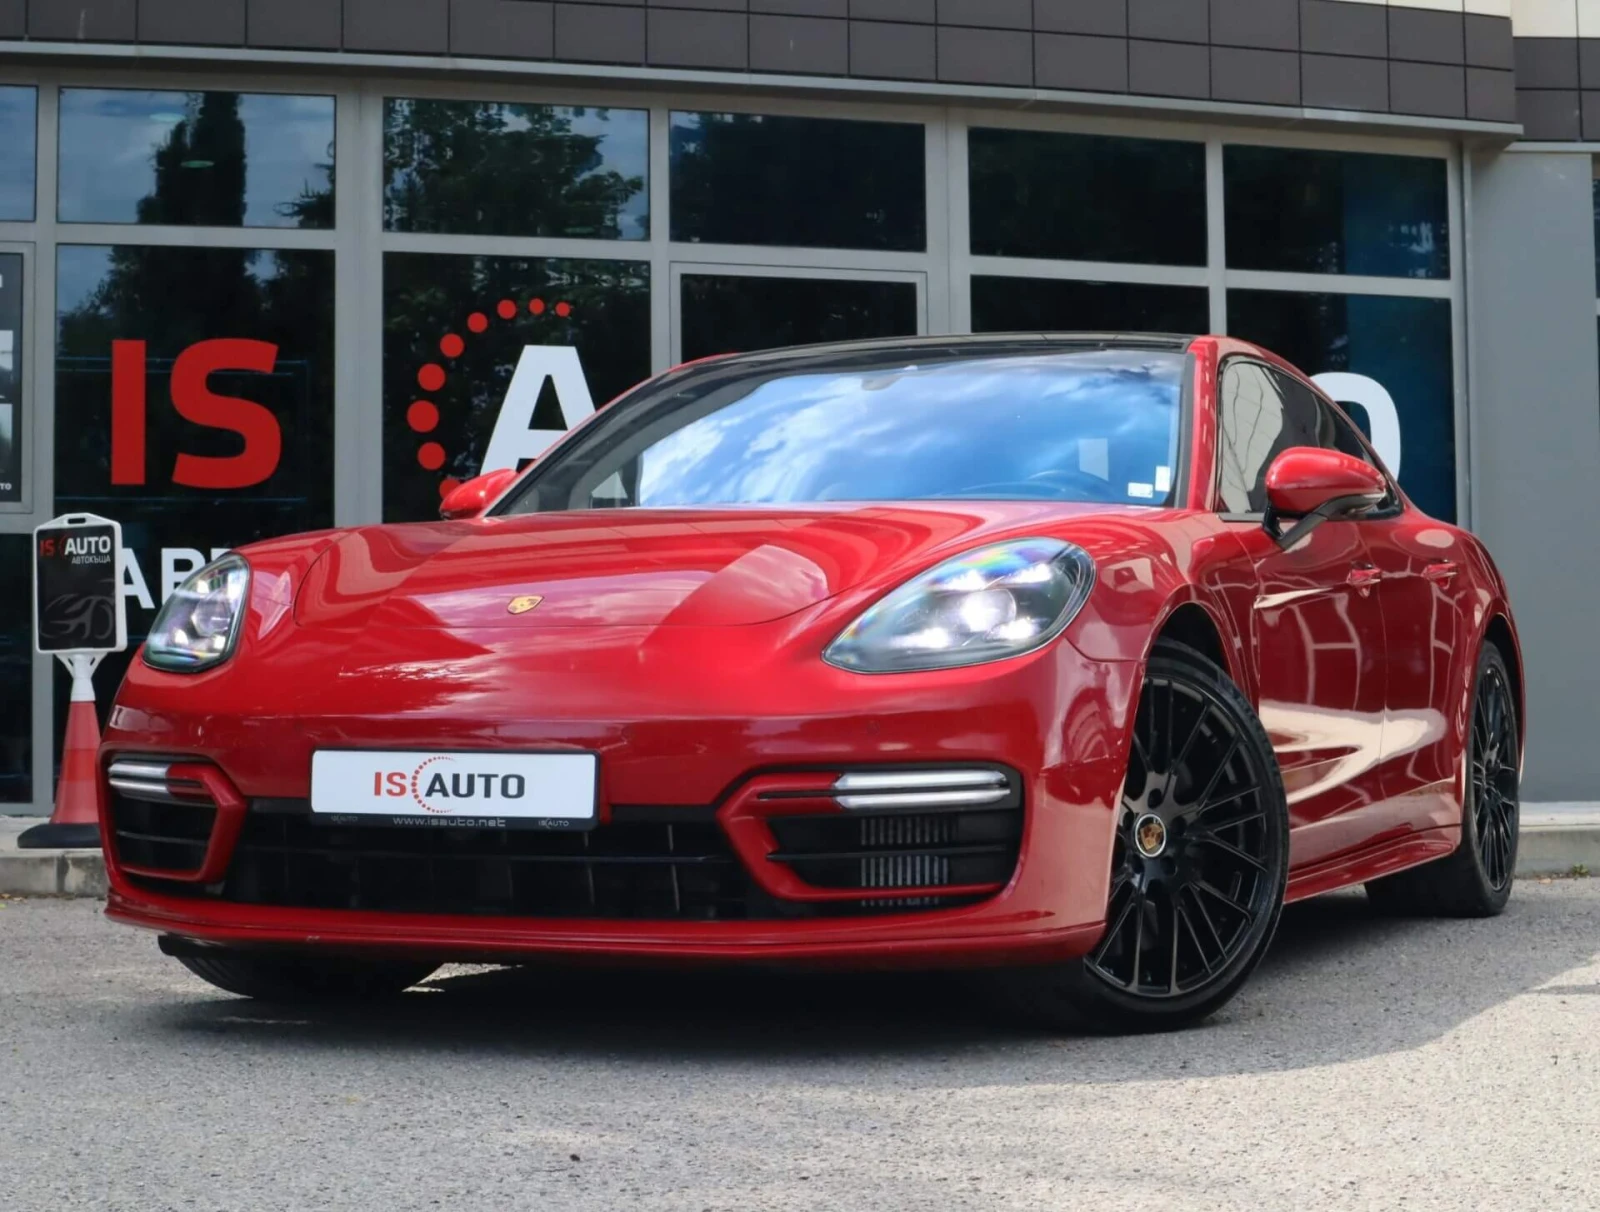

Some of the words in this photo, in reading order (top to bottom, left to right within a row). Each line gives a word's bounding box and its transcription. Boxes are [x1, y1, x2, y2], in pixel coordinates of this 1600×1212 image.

[111, 338, 282, 489] IS
[40, 538, 55, 556] IS
[64, 535, 111, 555] AUTO
[373, 771, 408, 797] IS
[424, 772, 525, 799] AUTO
[392, 816, 506, 828] www.isauto.net
